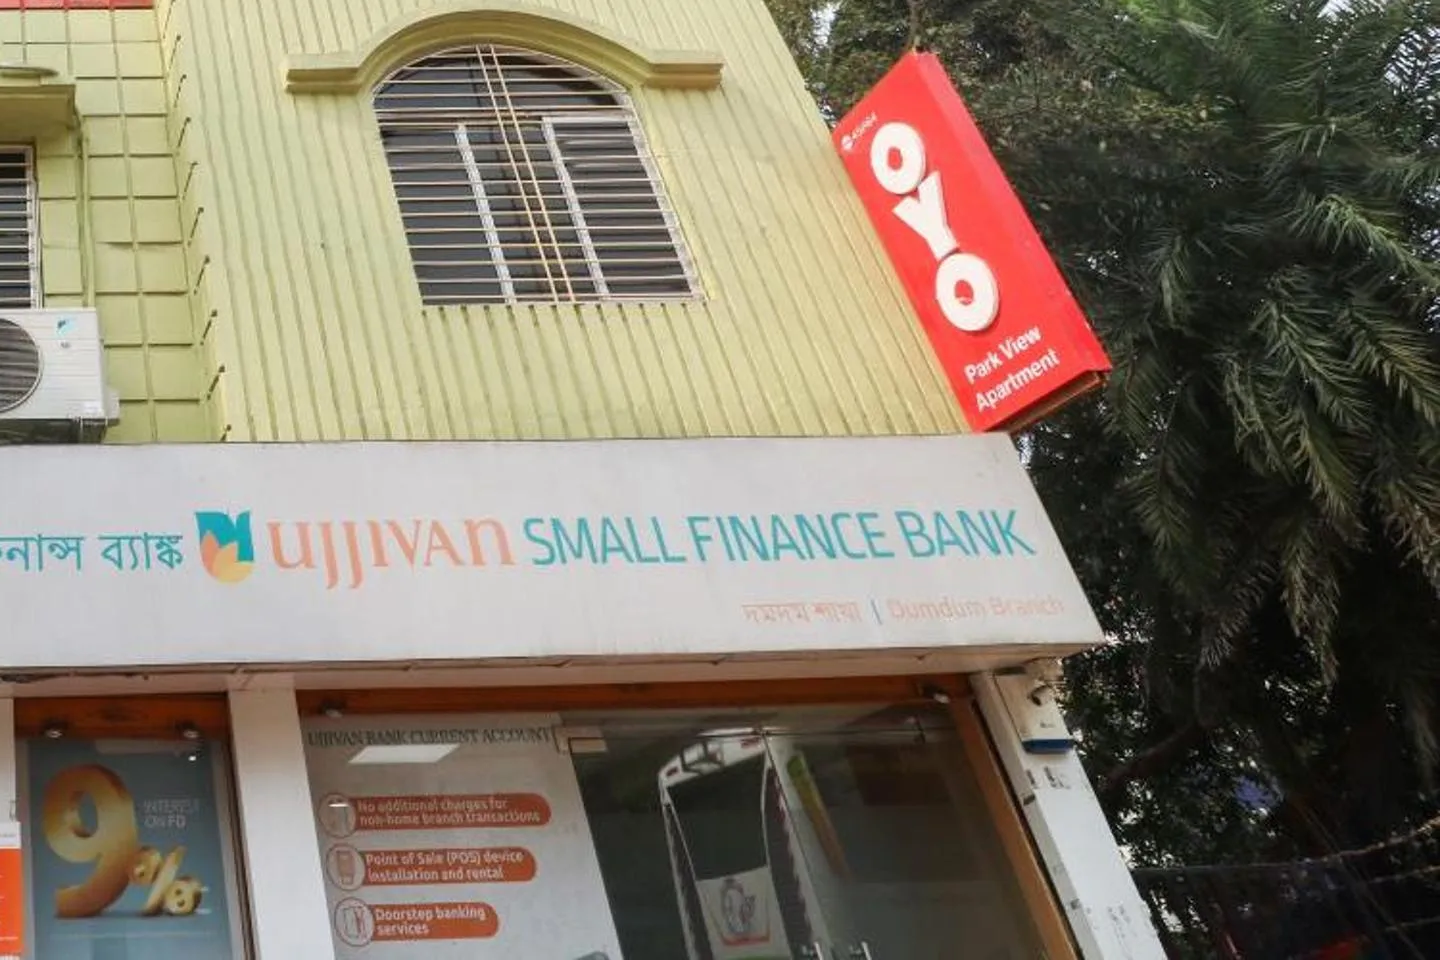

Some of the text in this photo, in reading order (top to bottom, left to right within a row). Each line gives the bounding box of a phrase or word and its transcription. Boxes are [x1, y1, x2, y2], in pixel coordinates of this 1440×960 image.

[870, 122, 999, 331] OYO
[964, 325, 1042, 384] Park View
[975, 348, 1060, 413] Apartment
[523, 516, 687, 565] SMALL
[686, 511, 895, 562] FINANCE
[895, 509, 1037, 558] BANK
[378, 798, 439, 812] additional
[423, 812, 464, 824] branch
[366, 850, 524, 866] Point of Sale (POS) device
[442, 868, 462, 880] and
[466, 867, 504, 880] rental
[376, 906, 485, 923] Doorstep banking
[376, 923, 429, 936] services
